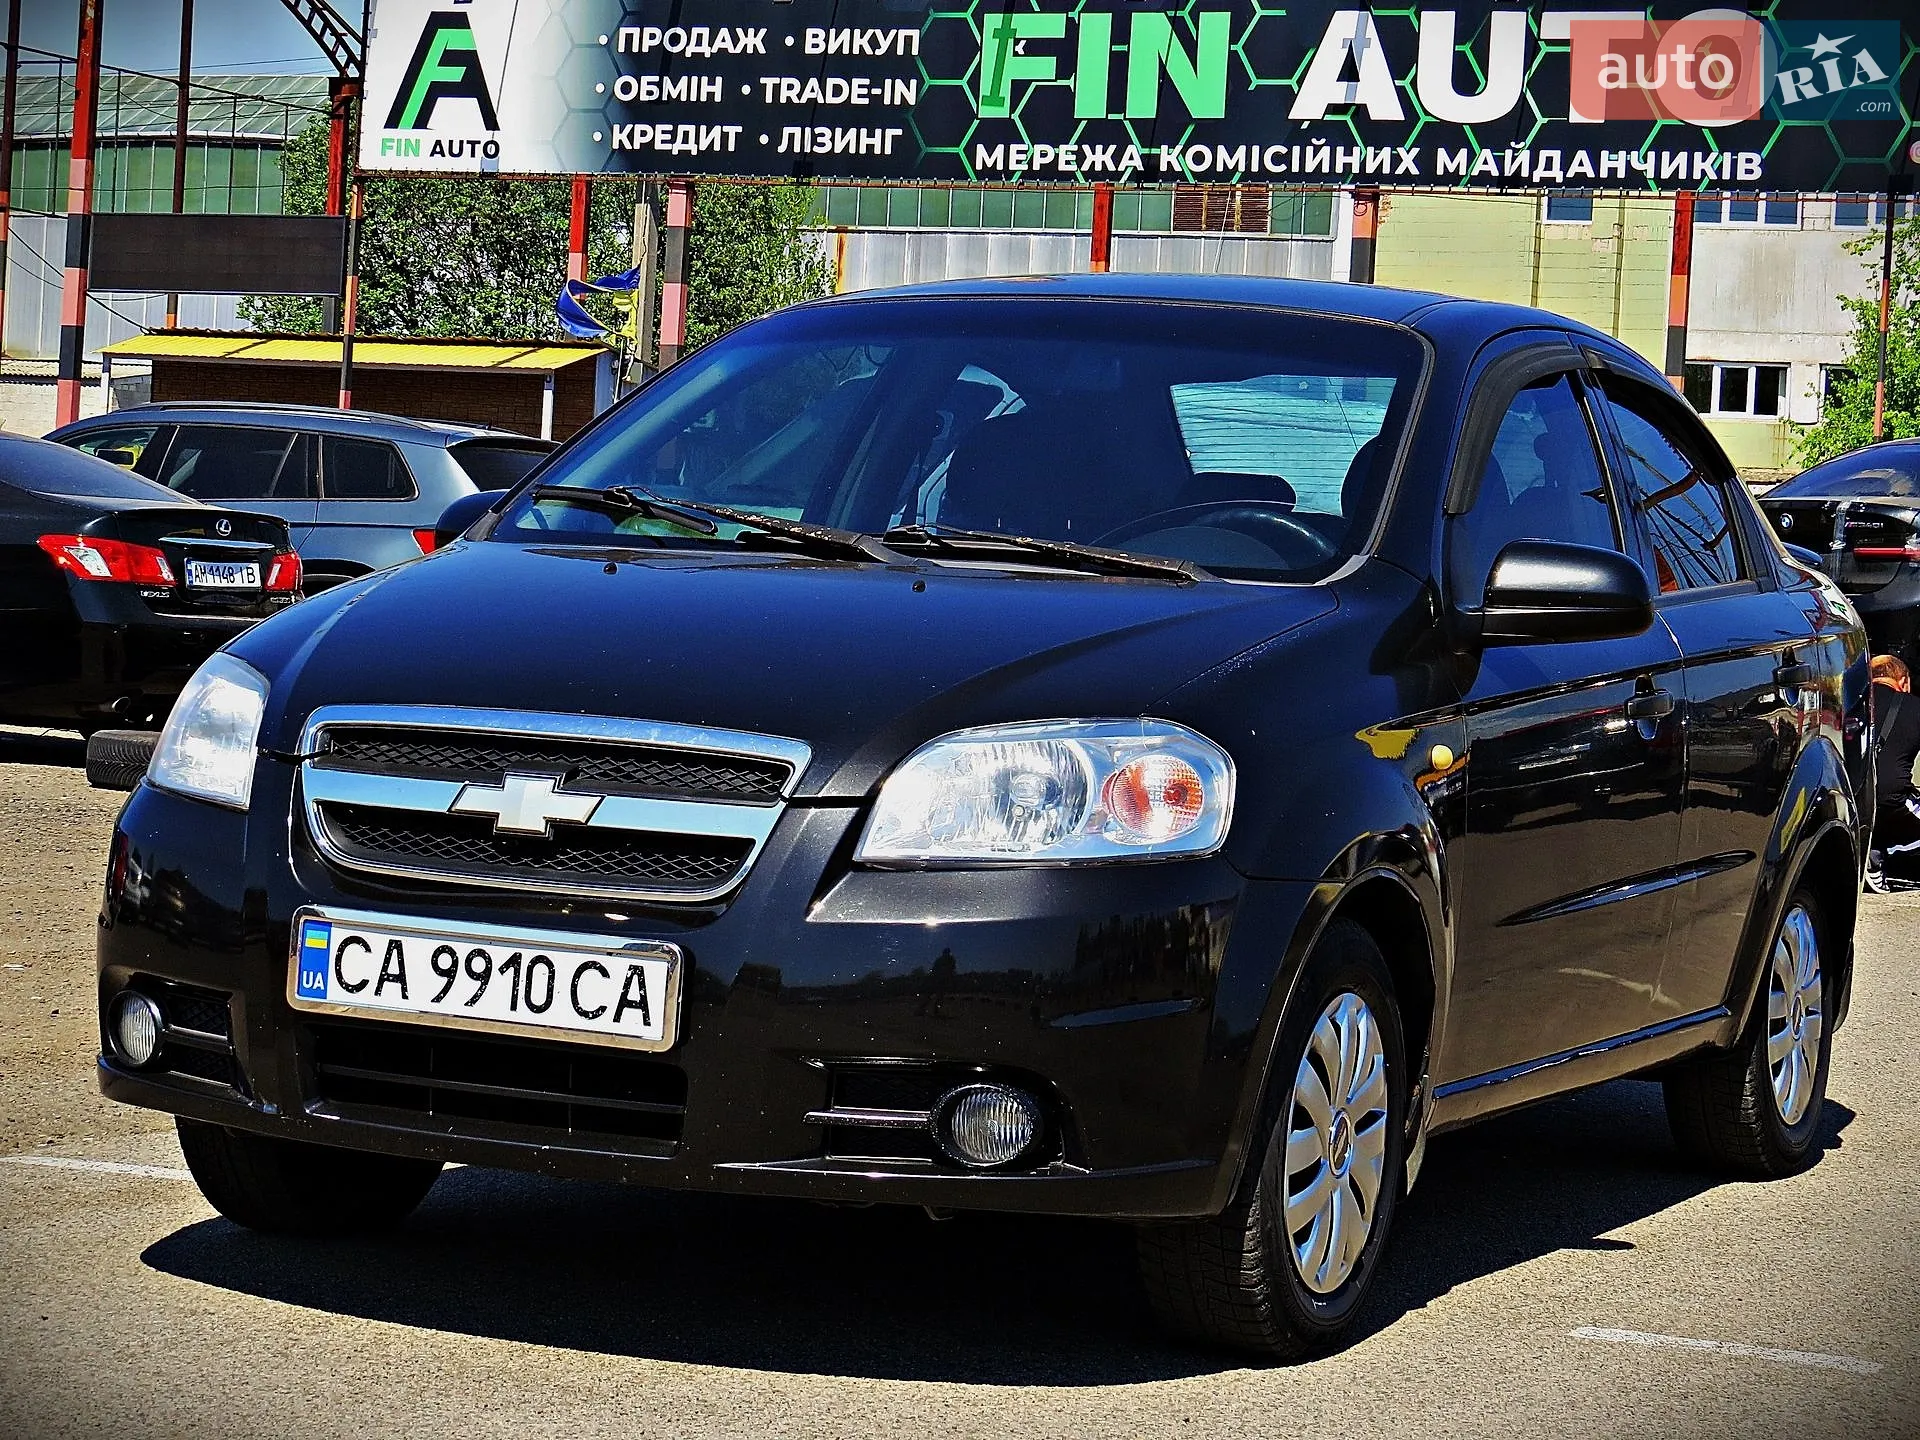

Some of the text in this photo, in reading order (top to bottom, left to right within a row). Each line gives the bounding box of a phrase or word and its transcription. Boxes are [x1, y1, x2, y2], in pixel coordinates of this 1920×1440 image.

[616, 27, 920, 56] ПРОДАЖ ВИКУП
[977, 9, 1766, 126] FIN AUTO
[613, 75, 918, 106] ОБМІН TRADE-IN
[381, 138, 501, 159] FIN AUTO
[611, 124, 903, 154] КРЕДИТ ЛІЗИНГ
[975, 138, 1763, 182] МЕРЕЖА КОМІСІЙНИХ МАЙДАНЧИКІВ
[208, 565, 235, 584] 1148
[302, 935, 652, 1027] UA CA 9910 CA
